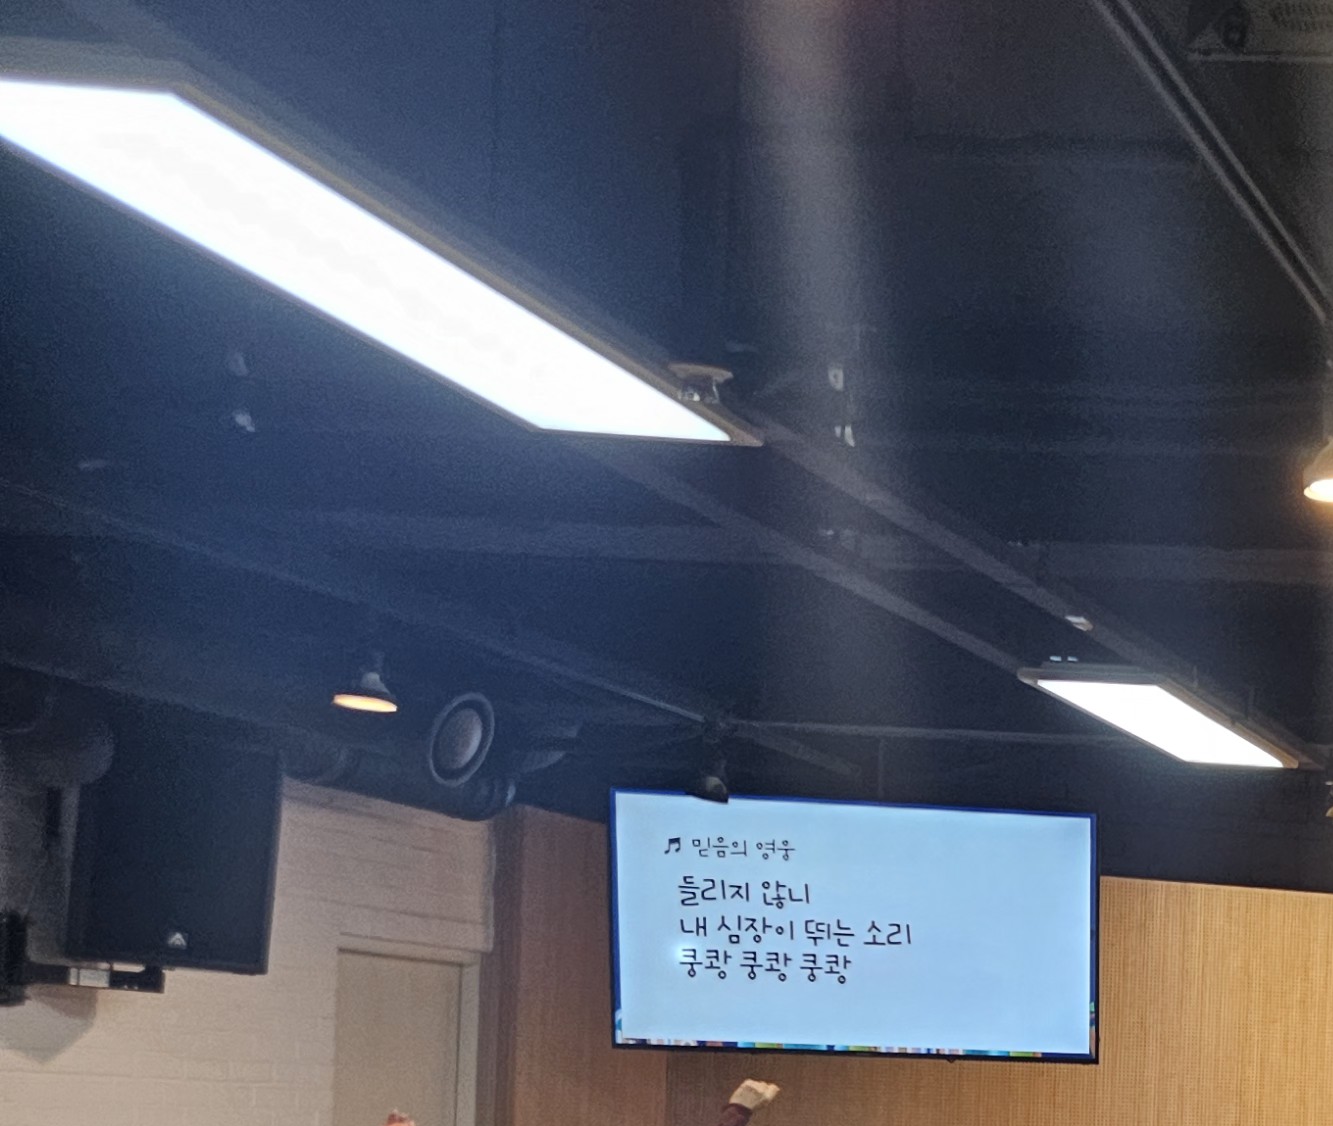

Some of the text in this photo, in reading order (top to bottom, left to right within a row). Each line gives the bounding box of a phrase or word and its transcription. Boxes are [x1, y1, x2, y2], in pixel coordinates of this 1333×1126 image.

[691, 836, 796, 862] 믿음의 영웅
[677, 875, 810, 910] 들리지 않니
[679, 914, 913, 948] 내 심장이 뛰는 소리
[679, 948, 852, 985] 쿵쾅 쿵쾅 쿵쾅
